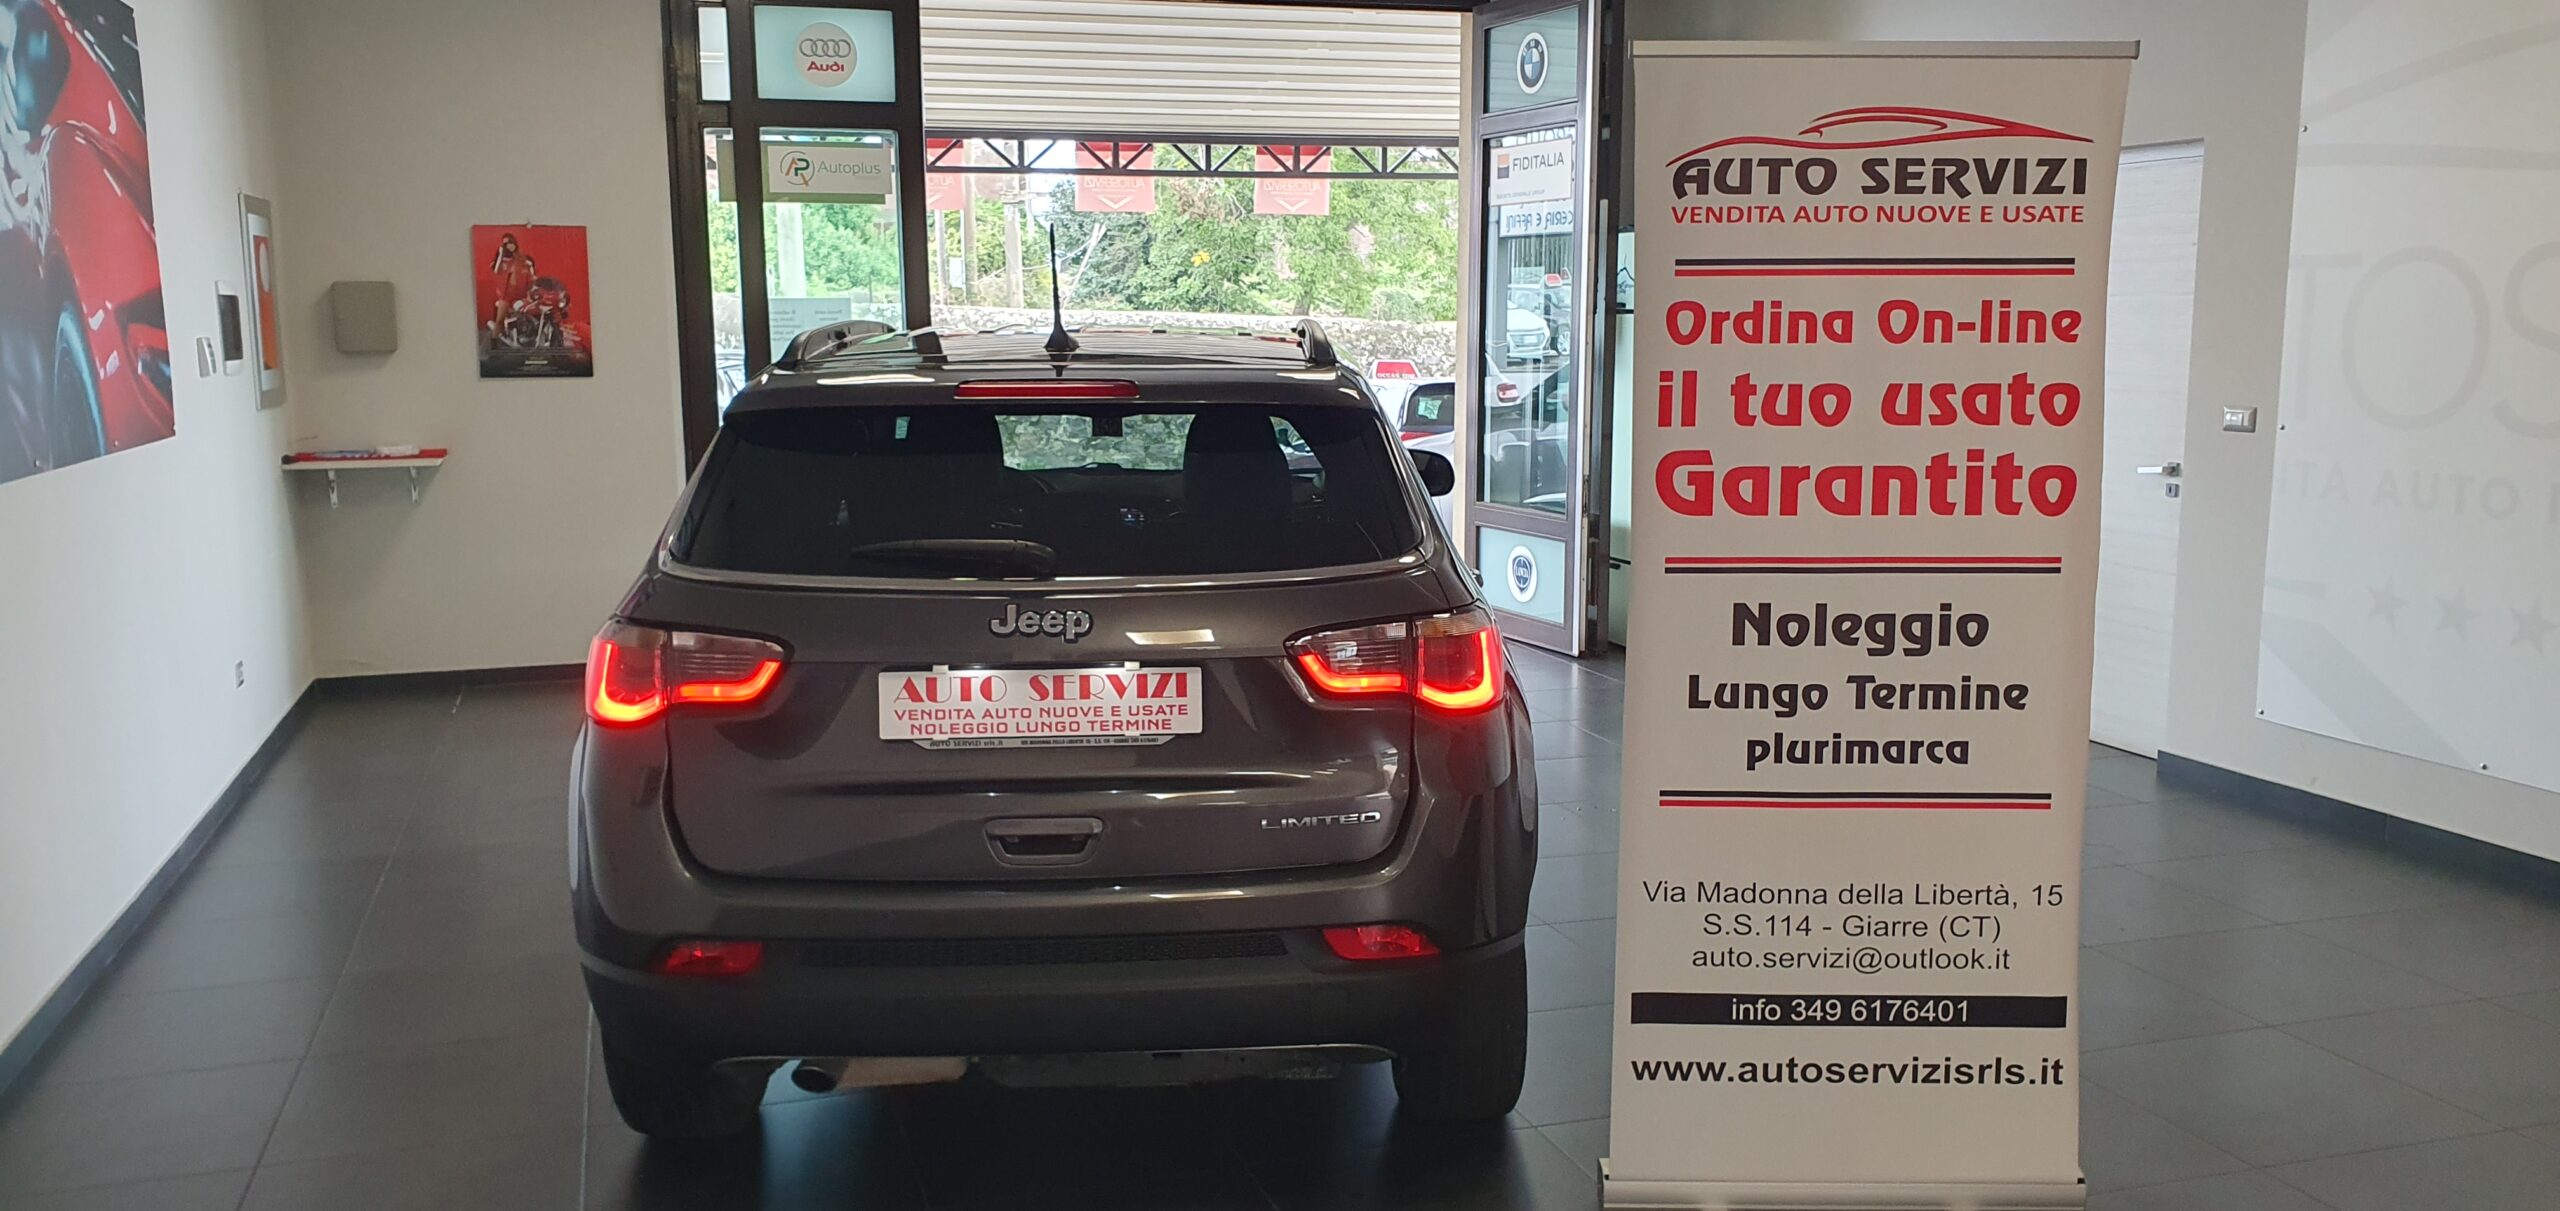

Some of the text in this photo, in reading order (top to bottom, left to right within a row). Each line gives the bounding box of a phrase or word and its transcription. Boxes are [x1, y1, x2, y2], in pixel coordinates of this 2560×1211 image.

[807, 60, 845, 73] Audi
[817, 161, 882, 176] Autoplus
[1512, 151, 1565, 172] FIDITALIA
[1671, 157, 2088, 200] AUTO SERVIZI
[1671, 205, 2084, 224] VENDITA AUTO NUOVE E USATE
[1665, 299, 2082, 346] Ordina On-line
[1657, 370, 2081, 428] il tuo usato
[1655, 448, 2078, 518] Garantito
[2372, 469, 2522, 521] AUTO
[990, 604, 1091, 641] Jeep
[1731, 602, 1990, 657] Noleggio
[893, 672, 1189, 704] AUTO SERVIZI
[1688, 674, 2030, 718] Lungo Termine
[894, 704, 1189, 721] VENDITA AUTO NUOVE E USATE
[910, 718, 1173, 736] NOLEGGIO LUNGO TERMINE
[1746, 732, 1969, 772] plurimarca
[1261, 812, 1381, 830] LIMITED
[1642, 880, 2064, 909] Via Madonna della Libertà, 15
[1702, 913, 1812, 937] S.S.114
[1842, 914, 1929, 938] Giarre
[1938, 915, 2002, 944] (CT)
[1691, 946, 2011, 975] auto.servizi@outlook.it
[1731, 998, 1969, 1023] info 349 6176401
[1631, 1055, 2065, 1086] www.autoservizisrls.it
